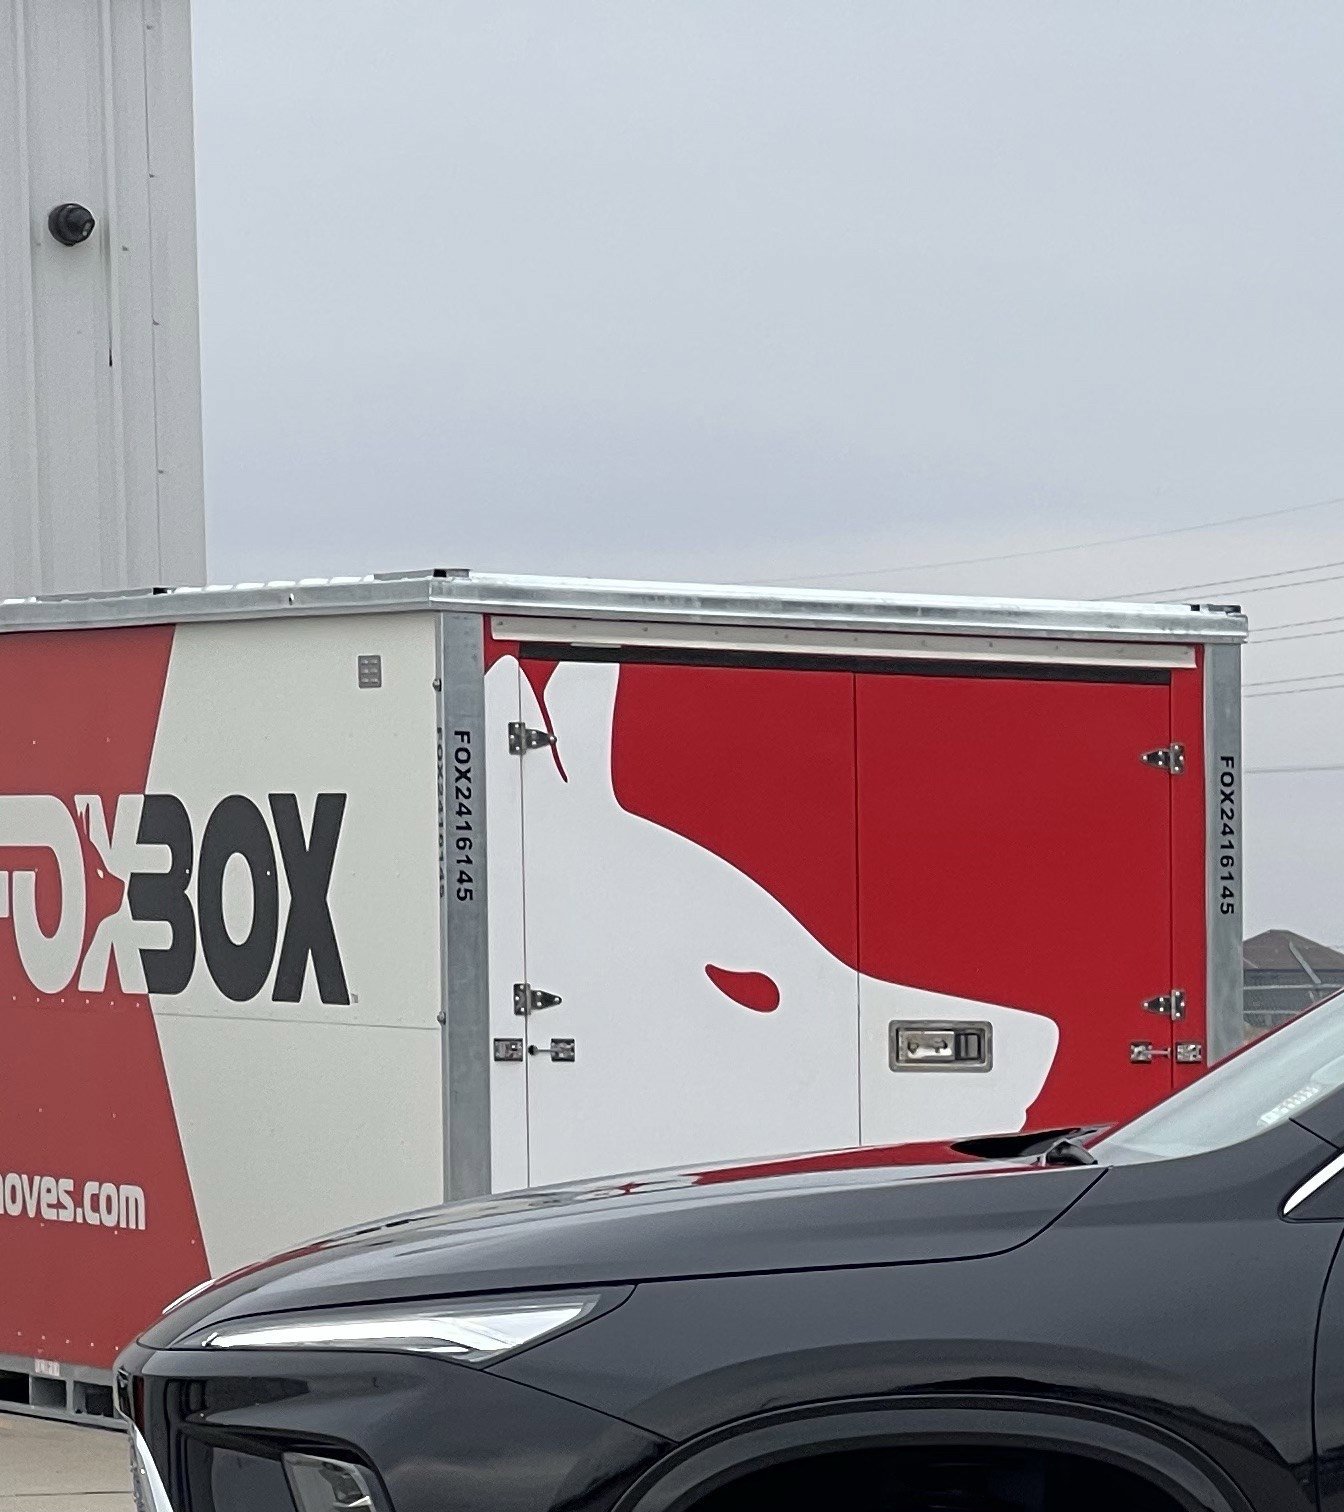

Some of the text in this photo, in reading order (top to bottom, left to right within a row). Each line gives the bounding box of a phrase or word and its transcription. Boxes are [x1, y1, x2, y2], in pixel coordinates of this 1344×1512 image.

[454, 730, 474, 902] FOX2416145
[1220, 755, 1235, 914] FOX2416145
[0, 792, 351, 1006] OXBOX
[0, 1172, 147, 1231] oves.com
